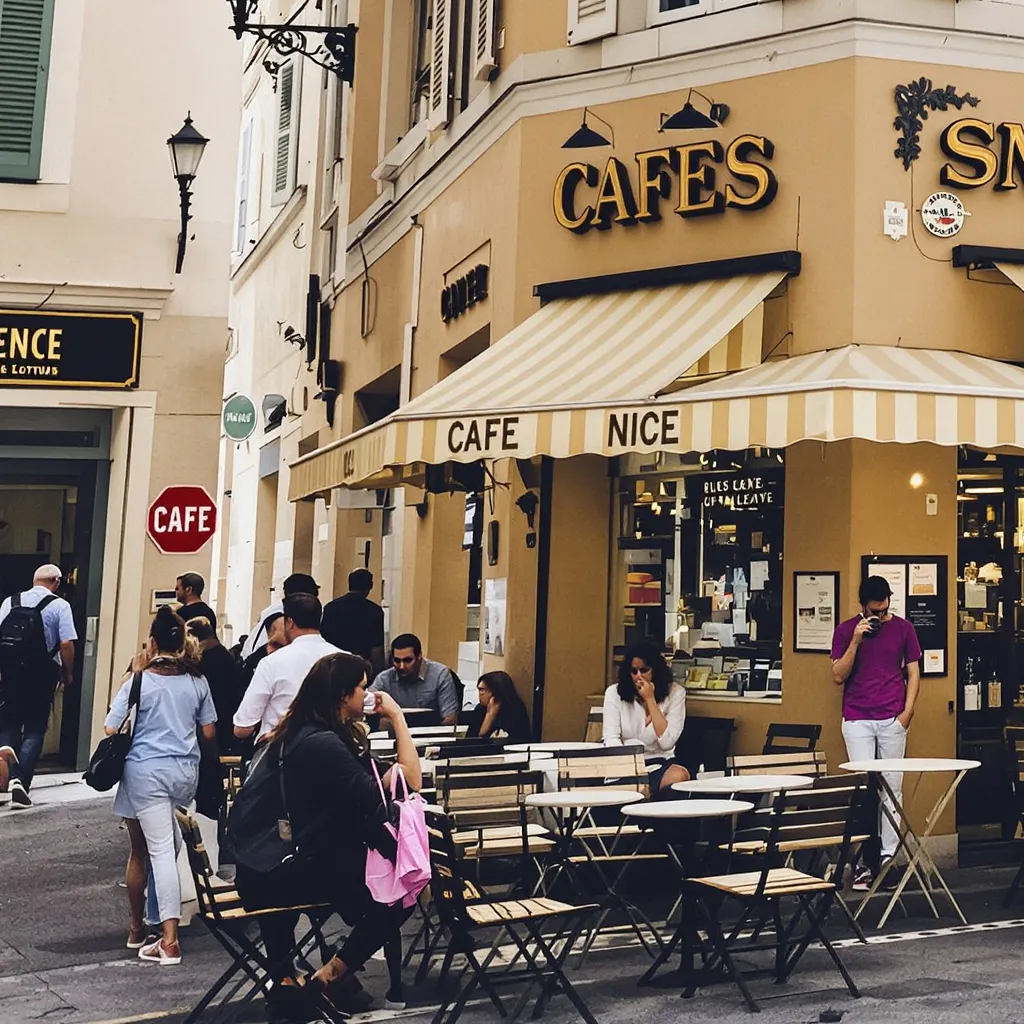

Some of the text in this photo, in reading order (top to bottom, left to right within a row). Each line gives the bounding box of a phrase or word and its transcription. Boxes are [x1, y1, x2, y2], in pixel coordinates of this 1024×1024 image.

[553, 134, 779, 235] CAFES
[447, 416, 520, 454] CAFE
[607, 409, 679, 448] NICE
[153, 506, 212, 533] CAFE
